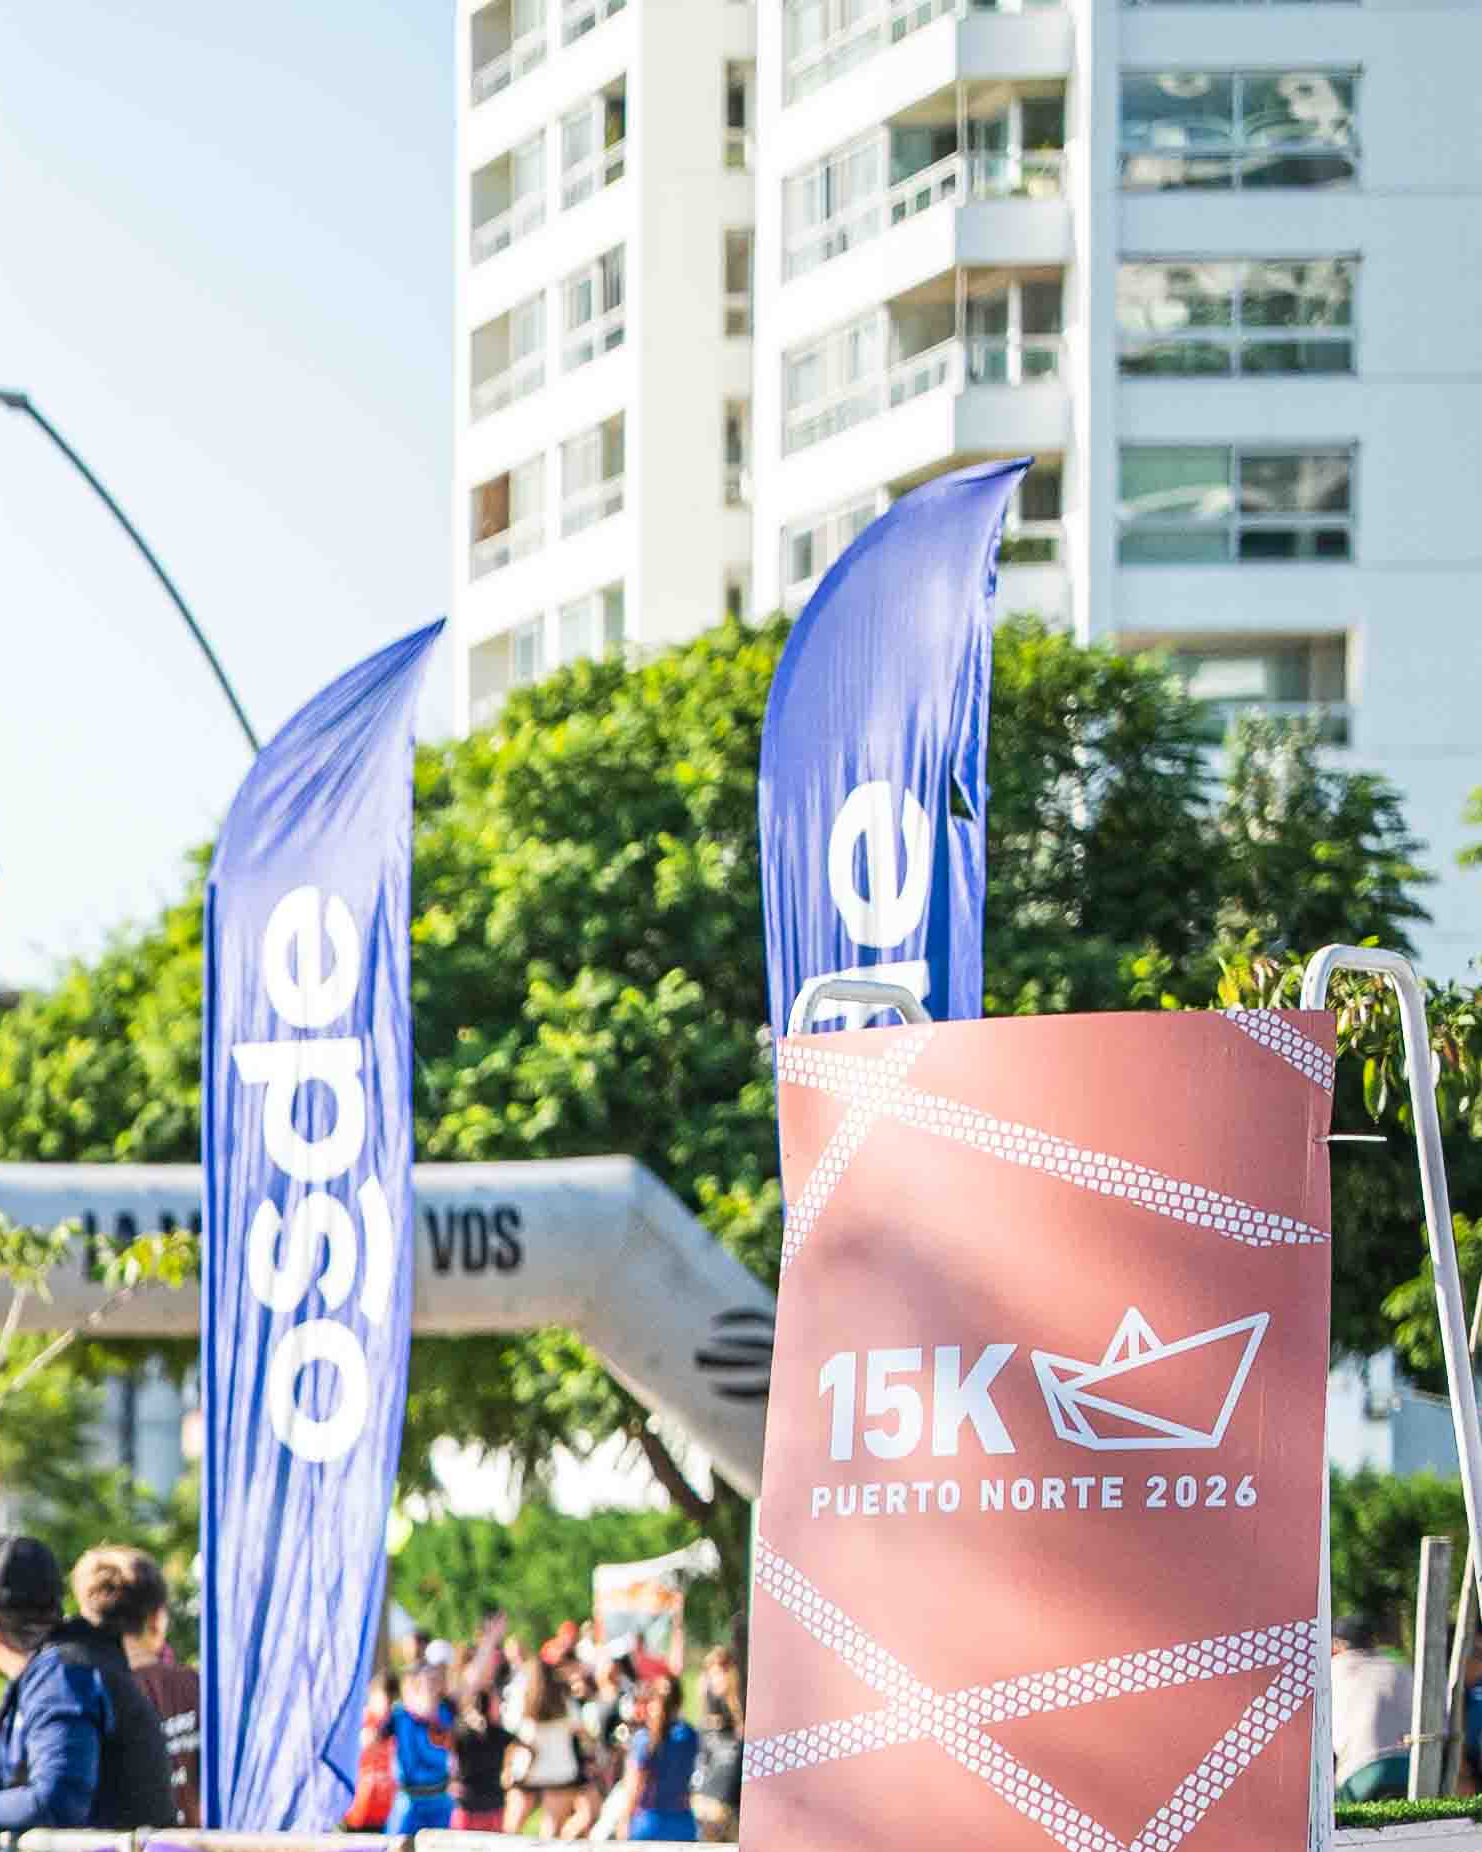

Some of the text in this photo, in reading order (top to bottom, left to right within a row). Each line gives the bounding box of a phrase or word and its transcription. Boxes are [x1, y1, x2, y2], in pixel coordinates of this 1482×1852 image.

[818, 1343, 1019, 1461] 15K
[811, 1474, 1258, 1520] PUERTO NORTE 2026
